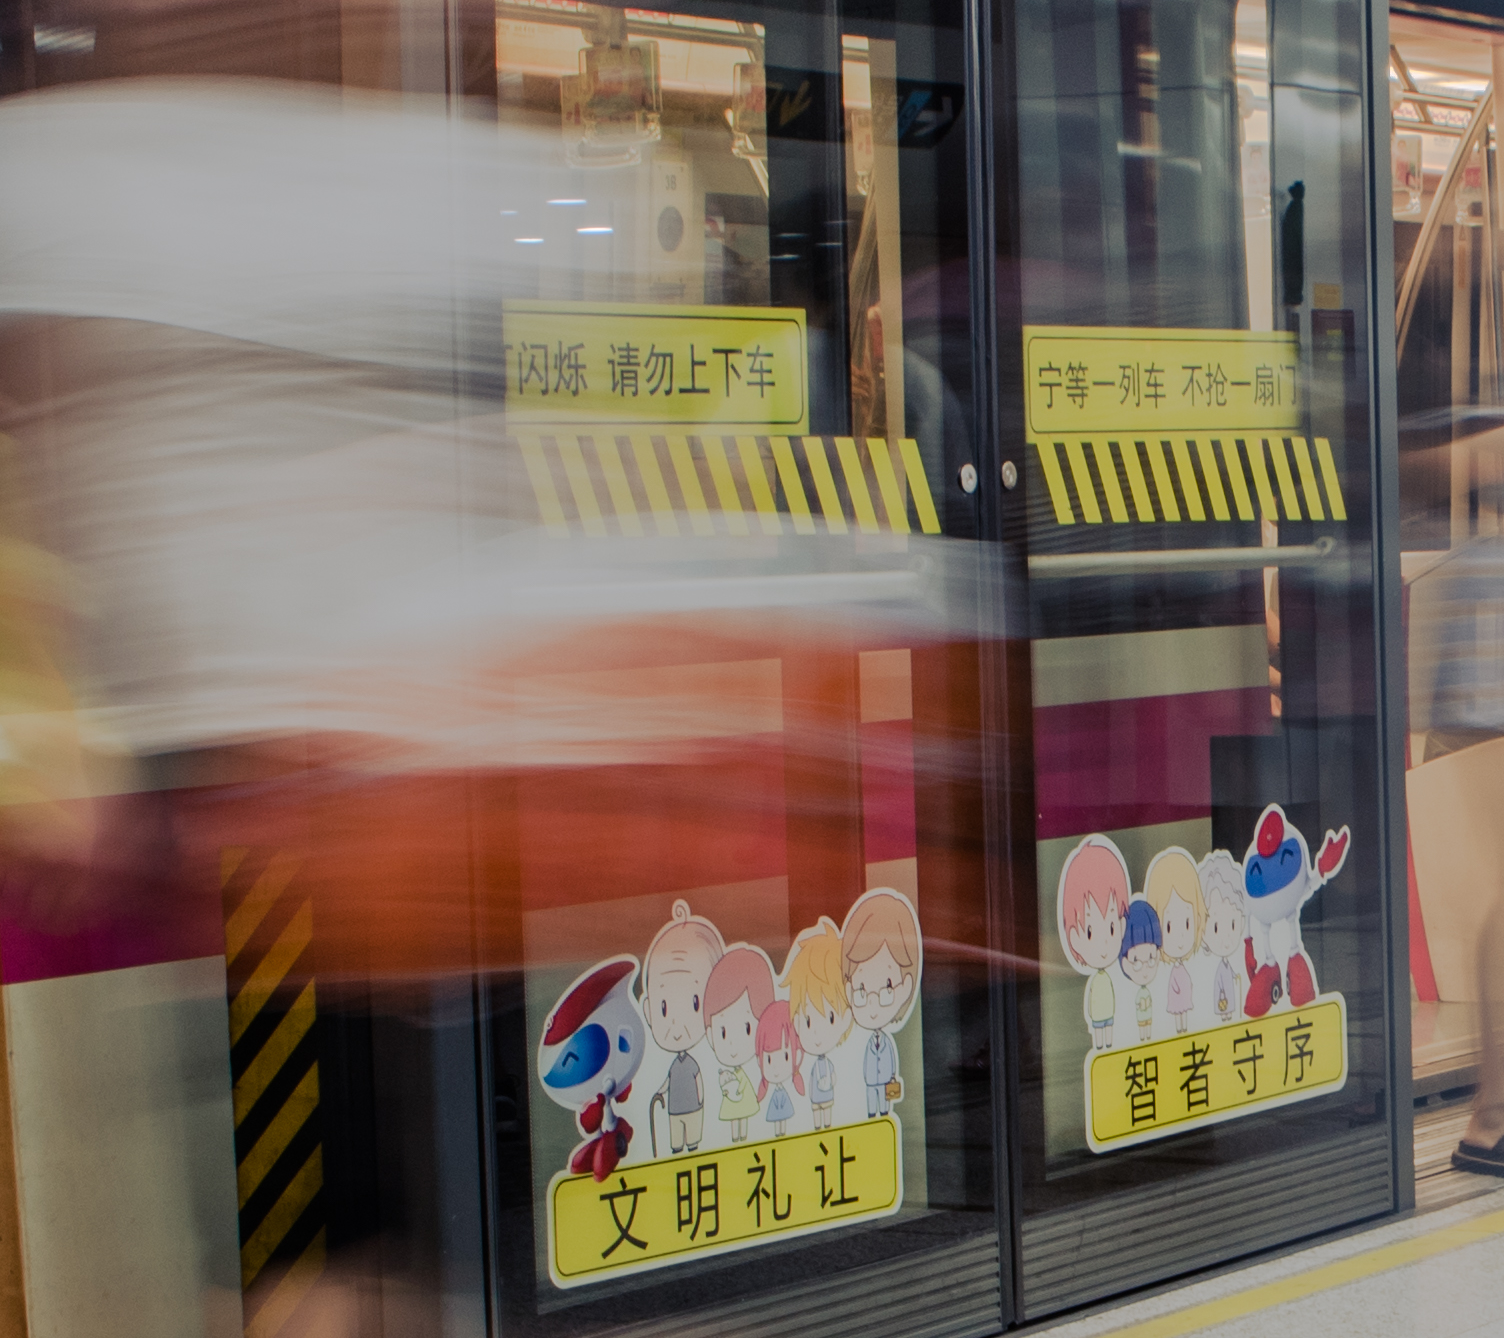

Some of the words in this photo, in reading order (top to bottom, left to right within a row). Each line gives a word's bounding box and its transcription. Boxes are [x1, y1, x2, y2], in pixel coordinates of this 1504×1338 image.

[504, 340, 588, 398] 闪烁
[607, 342, 776, 399] 请勿上下车
[1038, 362, 1166, 409] 宁等一列车
[1181, 363, 1296, 407] 不抢一扇门
[1124, 1017, 1314, 1127] 智者守序
[599, 1136, 860, 1259] 文明礼让
